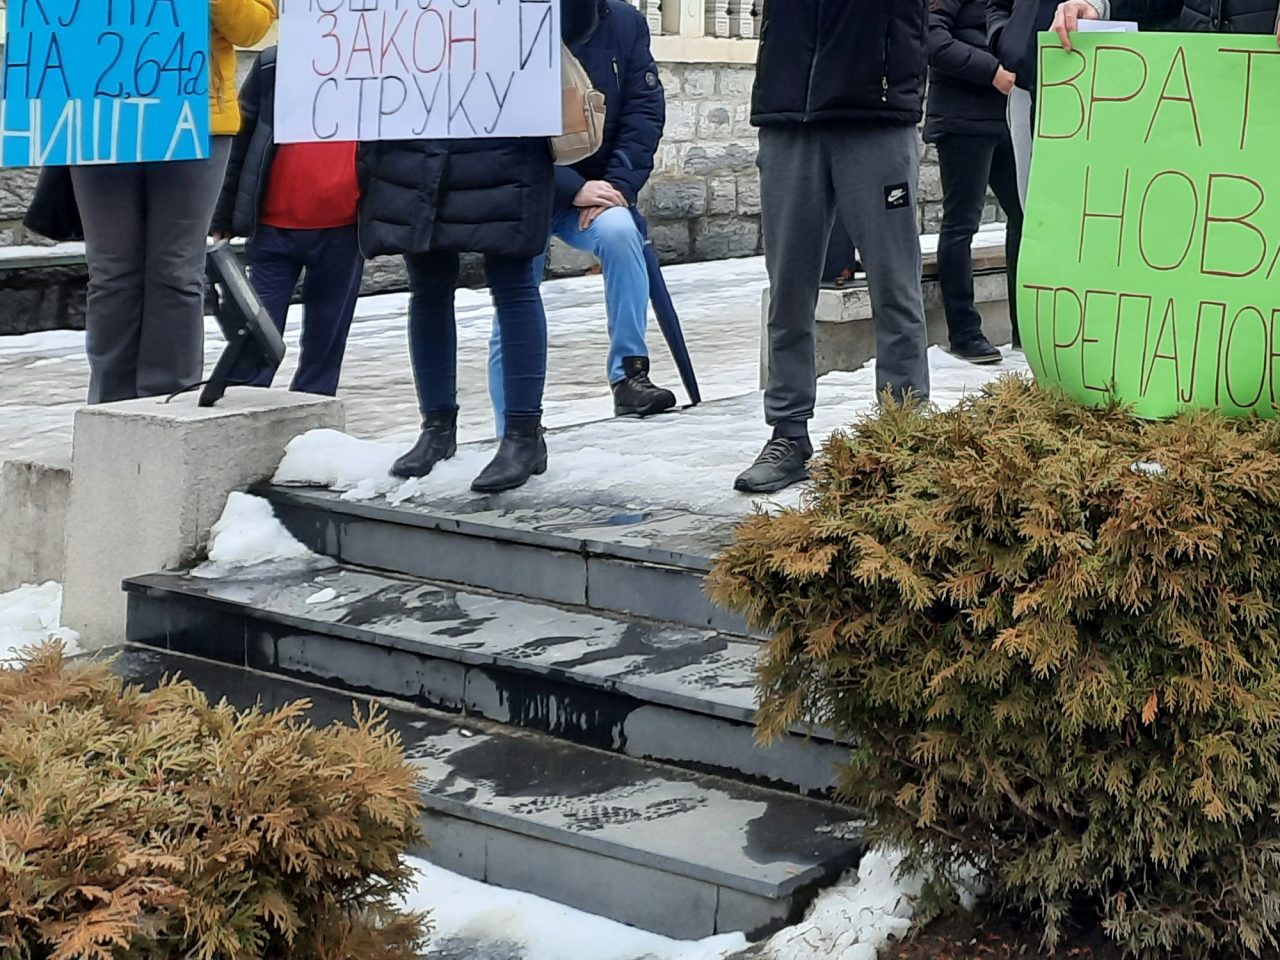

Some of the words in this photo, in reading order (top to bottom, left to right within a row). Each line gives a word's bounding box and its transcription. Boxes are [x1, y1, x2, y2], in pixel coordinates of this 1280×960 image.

[4, 32, 71, 99] НА
[312, 7, 477, 76] ЗАКОН
[519, 4, 552, 70] И
[1, 98, 202, 167] НИШТА
[312, 71, 515, 139] СТРУКУ
